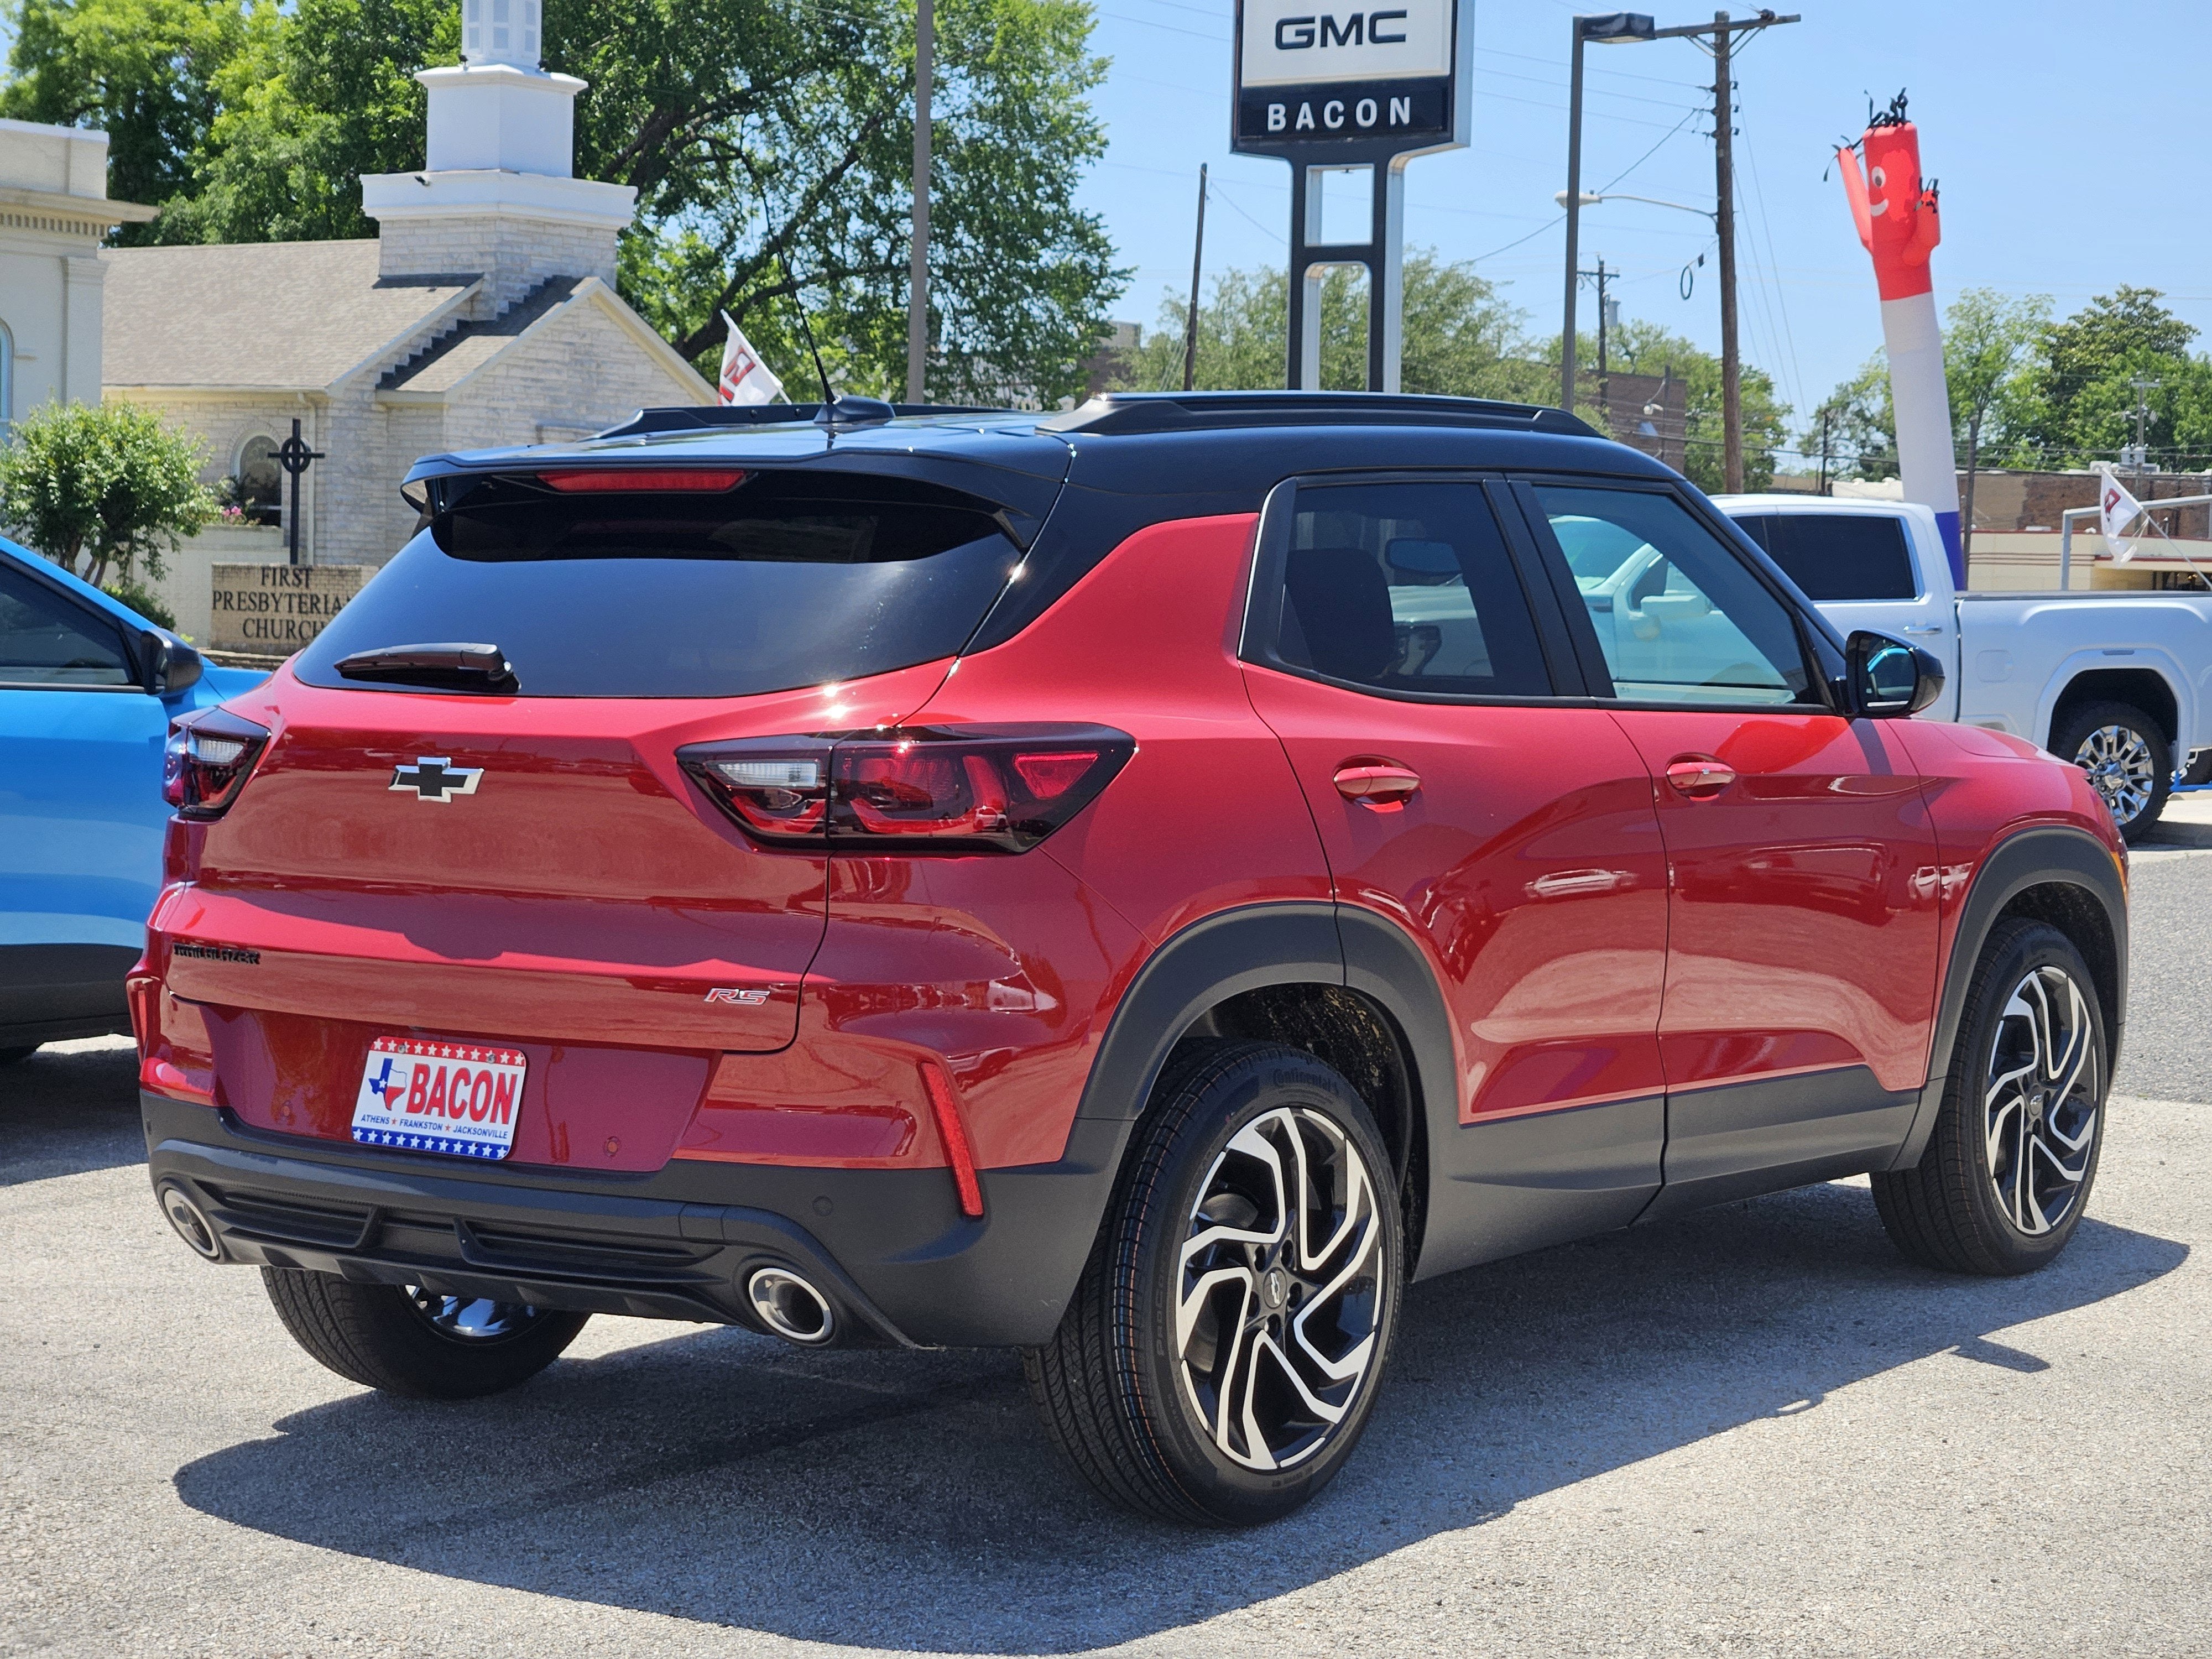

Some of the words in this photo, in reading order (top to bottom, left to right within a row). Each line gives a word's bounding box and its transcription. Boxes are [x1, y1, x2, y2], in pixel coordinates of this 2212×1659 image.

[1275, 9, 1407, 50] GMC
[1267, 96, 1410, 132] BACON
[261, 566, 313, 588] FIRST
[704, 988, 770, 1005] RS
[405, 1062, 518, 1125] BACON
[361, 1114, 390, 1125] ATHENS
[399, 1118, 443, 1131] FRANKSTON
[453, 1125, 508, 1139] JACKSONVILLE
